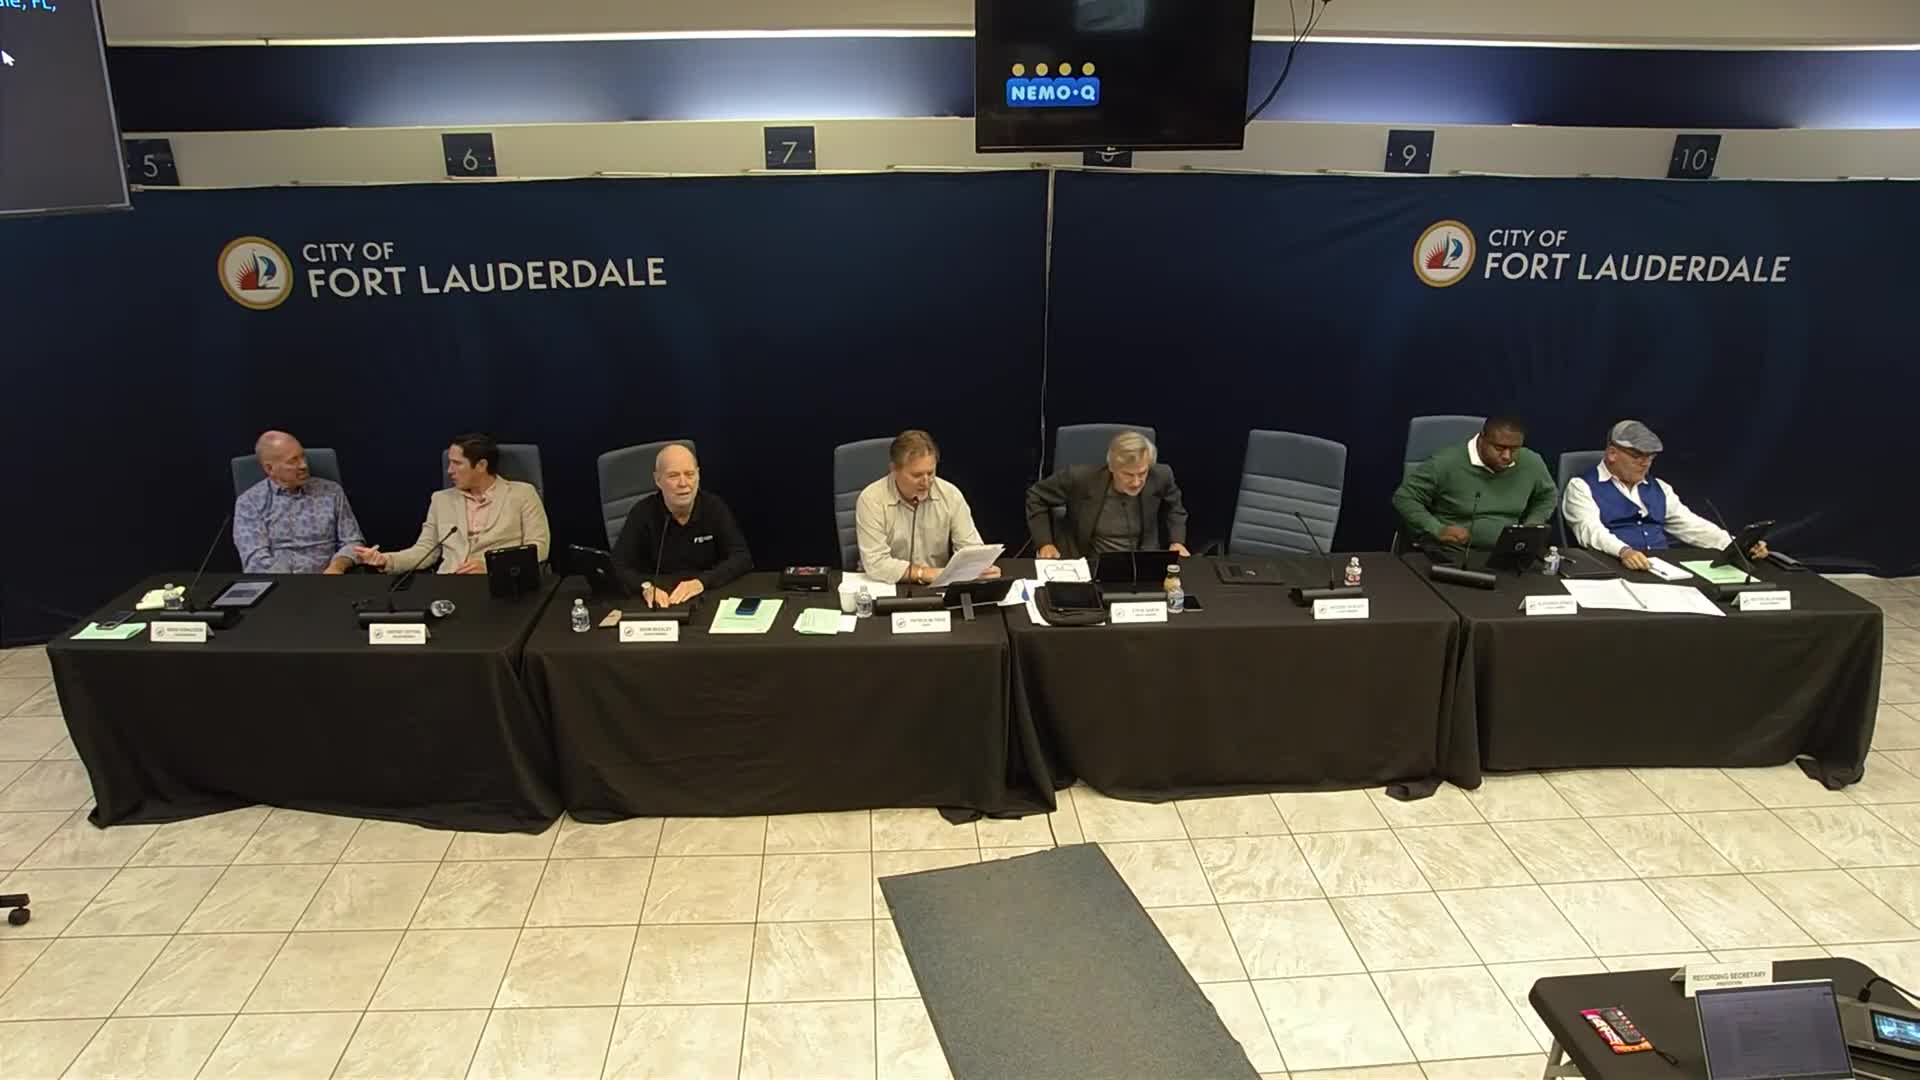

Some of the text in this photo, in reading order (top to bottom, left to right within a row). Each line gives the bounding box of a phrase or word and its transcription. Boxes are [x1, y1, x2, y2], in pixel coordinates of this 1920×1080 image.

[462, 148, 478, 171] 6
[781, 141, 798, 164] 7
[1402, 144, 1417, 167] 9
[1681, 148, 1708, 171] 10
[143, 153, 159, 178] 5
[1488, 229, 1568, 247] CITY OF
[302, 241, 394, 263] CITY OF
[307, 257, 667, 298] FORT LAUDERDALE
[1484, 252, 1791, 282] FORT LAUDERDALE
